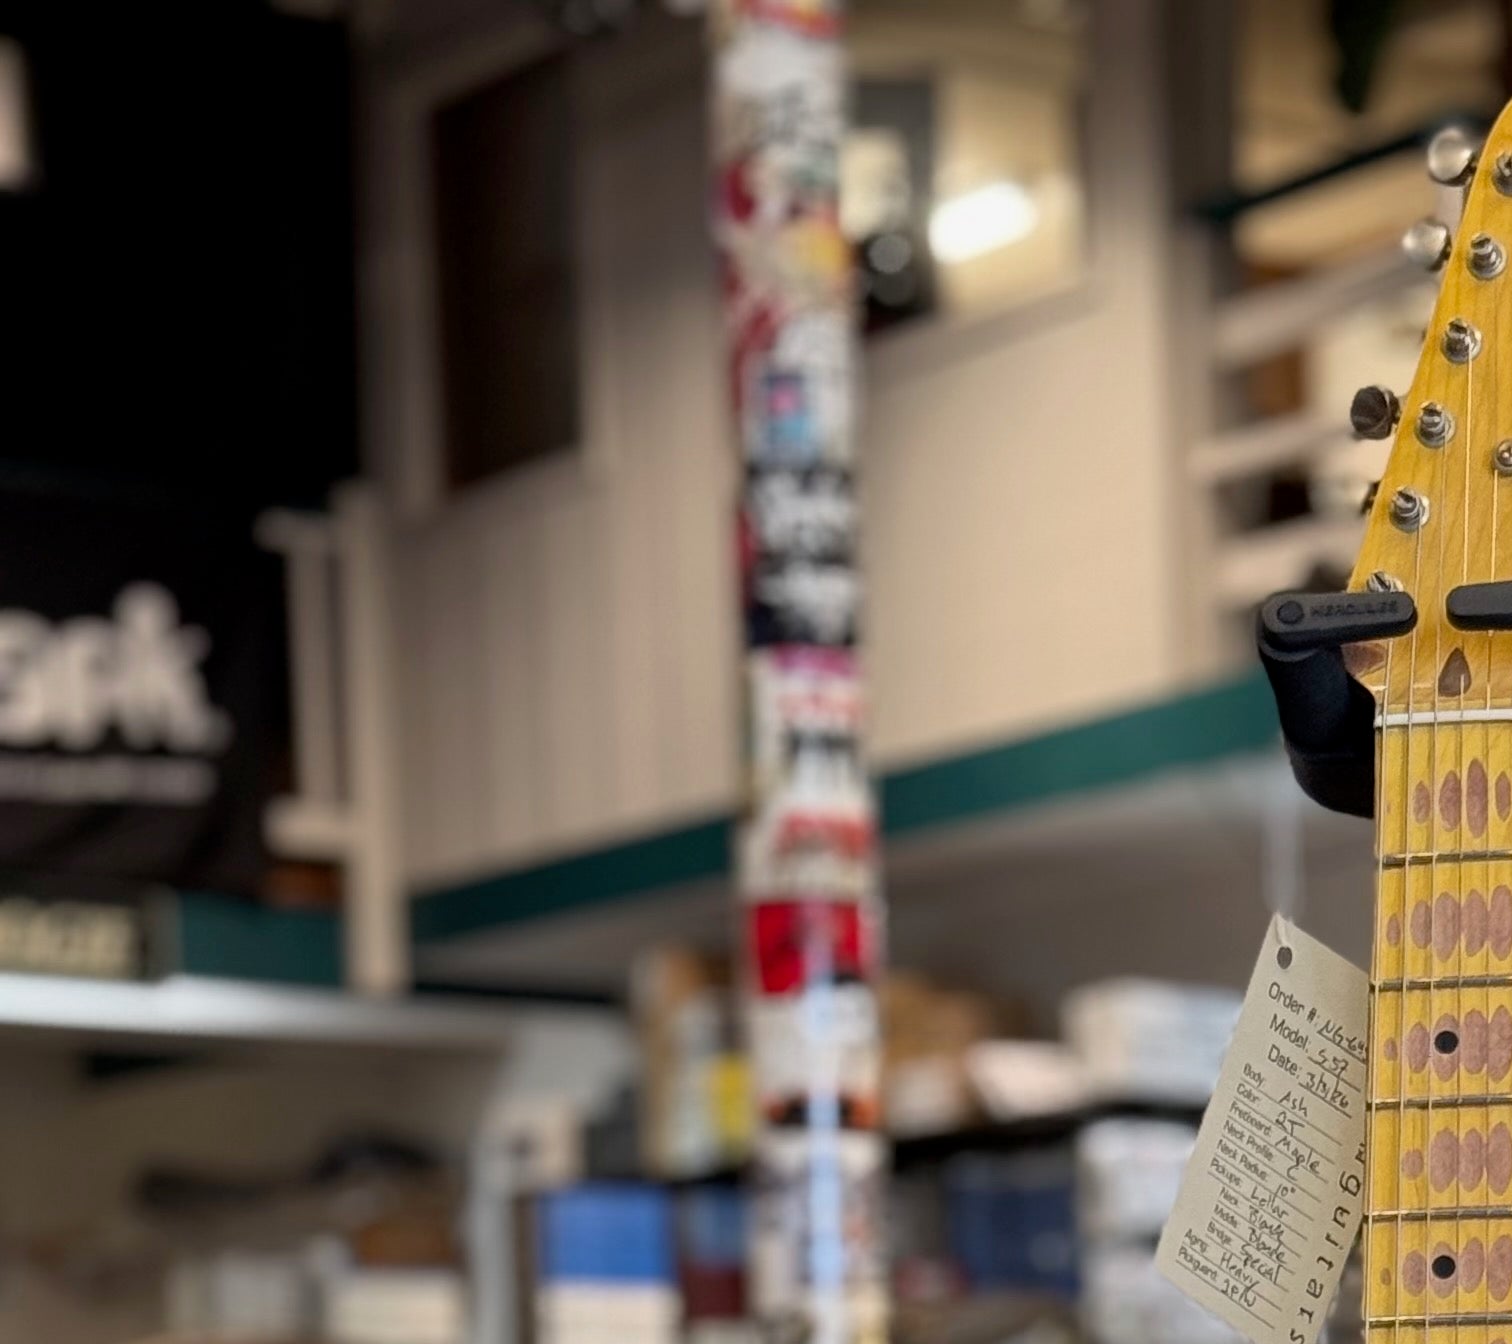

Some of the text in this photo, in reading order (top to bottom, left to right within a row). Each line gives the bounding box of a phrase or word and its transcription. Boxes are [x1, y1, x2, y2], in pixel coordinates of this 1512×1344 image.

[1265, 981, 1307, 1016] Order
[1267, 1013, 1316, 1053] Model:
[1264, 1044, 1306, 1079] Date:
